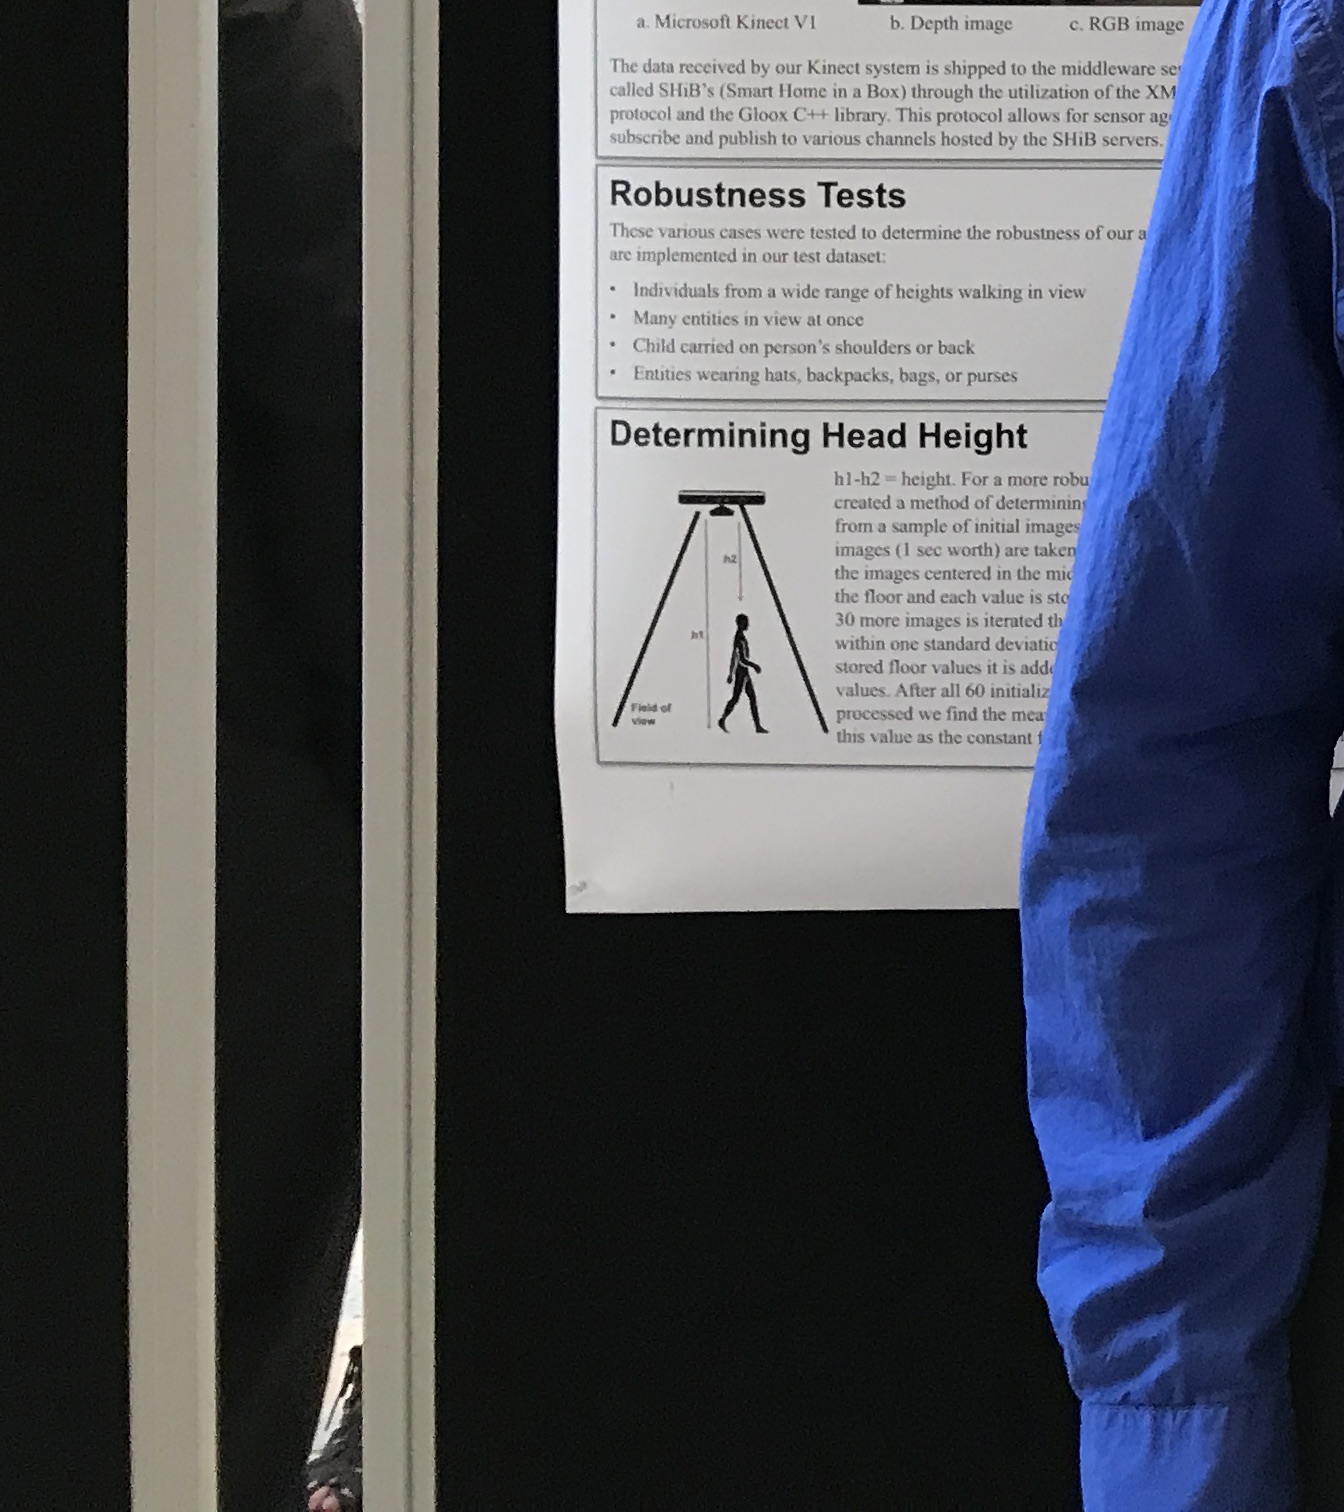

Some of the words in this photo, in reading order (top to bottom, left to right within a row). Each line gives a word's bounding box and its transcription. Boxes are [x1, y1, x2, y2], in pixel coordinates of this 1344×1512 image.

[636, 18, 650, 30] a.
[655, 13, 730, 31] Microsoft
[736, 14, 789, 31] Kinect
[794, 15, 817, 31] V1
[889, 15, 904, 31] b.
[911, 15, 960, 36] Depth
[965, 16, 1014, 35] image
[1069, 20, 1083, 32] c.
[1089, 16, 1131, 32] RGB
[1136, 17, 1185, 37] image
[610, 180, 806, 209] Robustness
[817, 180, 906, 209] Tests
[633, 282, 720, 299] Individuals
[725, 284, 763, 299] from
[767, 288, 777, 299] a
[782, 284, 820, 299] wide
[825, 288, 870, 304] range
[874, 283, 893, 299] of
[897, 284, 954, 303] heights
[958, 284, 1024, 303] walking
[1027, 286, 1044, 300] in
[1048, 287, 1086, 300] view
[610, 421, 811, 453] Determining
[821, 422, 907, 449] Head
[919, 422, 1029, 454] Height
